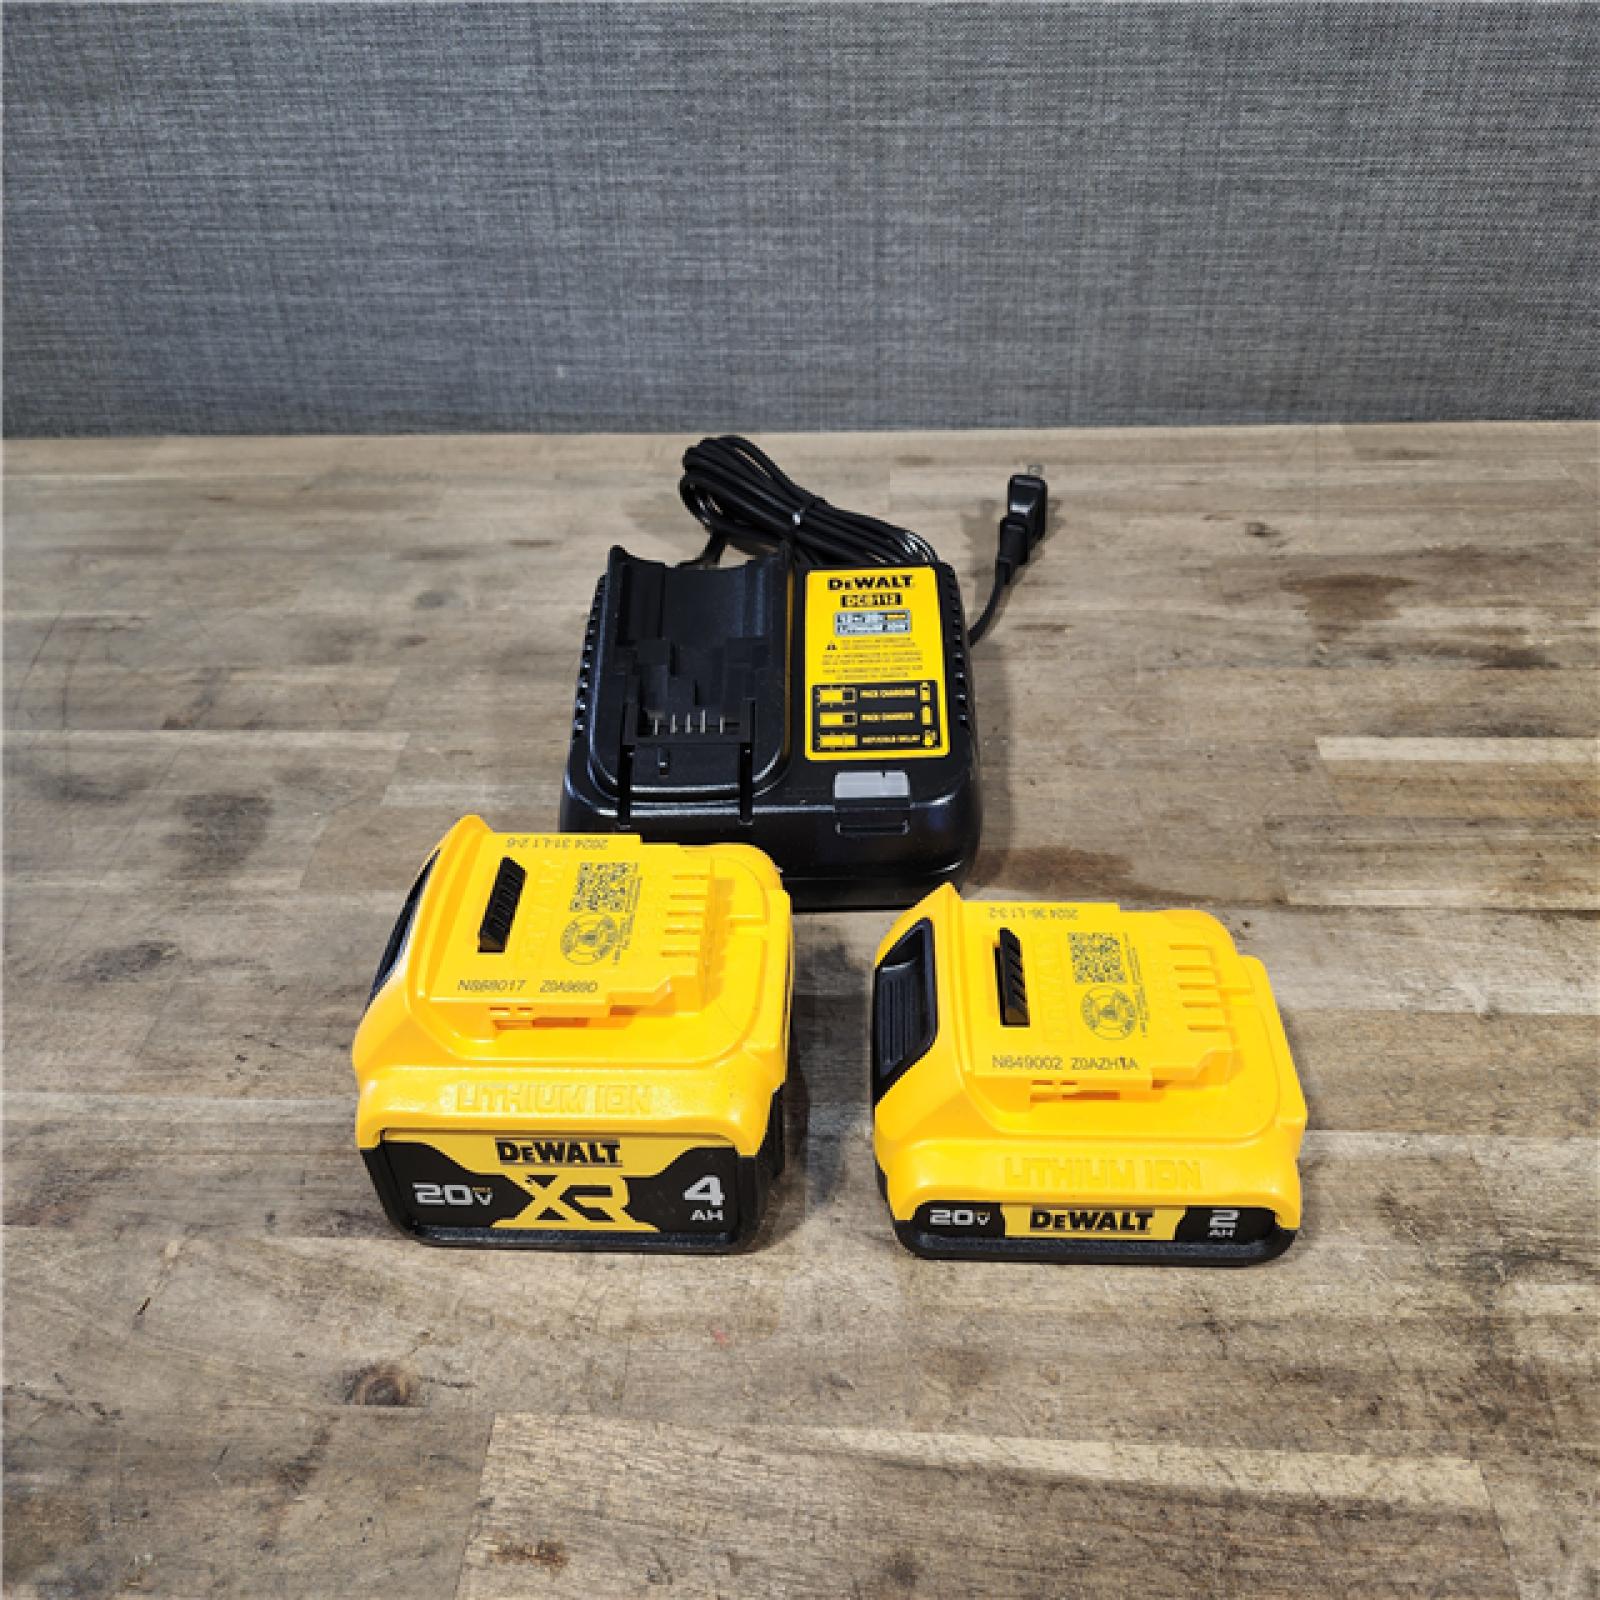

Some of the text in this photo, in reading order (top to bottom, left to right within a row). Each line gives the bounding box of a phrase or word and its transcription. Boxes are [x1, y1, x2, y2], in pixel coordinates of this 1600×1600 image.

[457, 1084, 651, 1114] LITHIUM ION
[1004, 1157, 1202, 1190] LITHIUM ION
[491, 1174, 661, 1231] XR
[683, 1175, 726, 1206] 4
[690, 1209, 723, 1221] AH
[1210, 1210, 1240, 1228] 2
